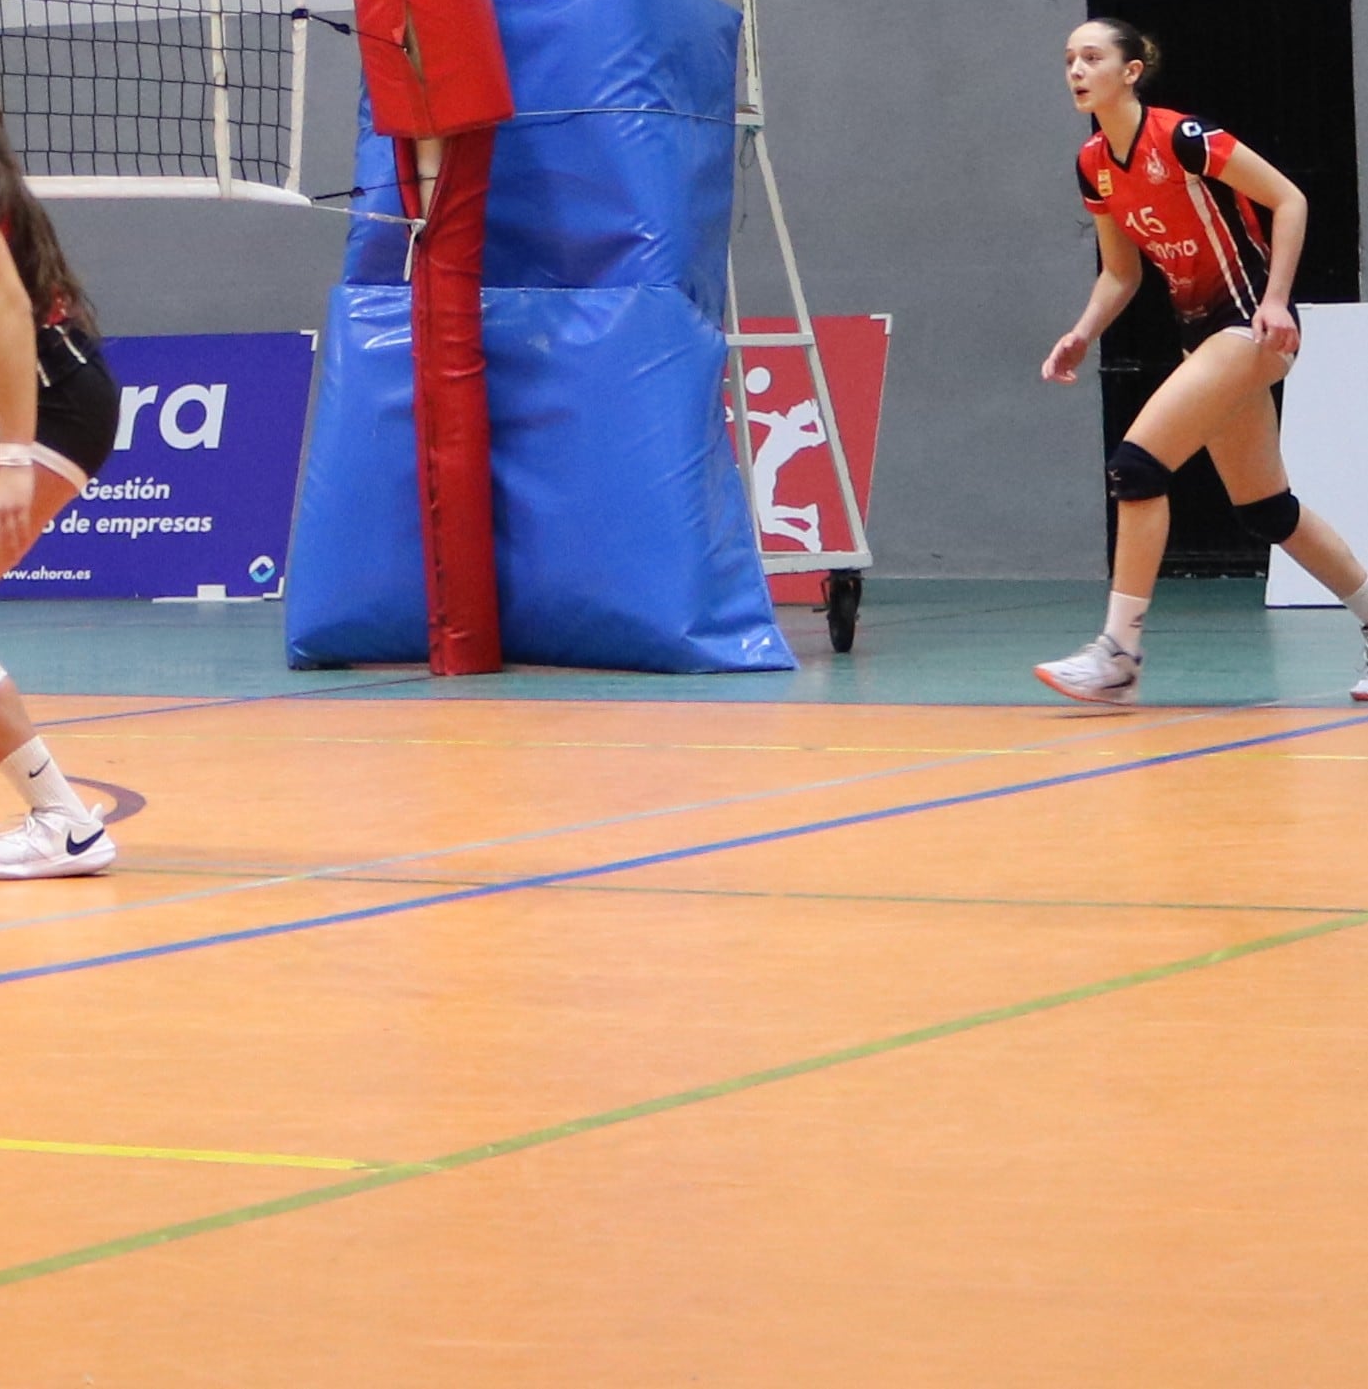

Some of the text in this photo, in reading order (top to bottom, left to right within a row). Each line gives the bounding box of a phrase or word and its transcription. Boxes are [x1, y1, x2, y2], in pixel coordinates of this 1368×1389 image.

[1125, 207, 1166, 237] 15
[81, 477, 170, 500] Gestión
[61, 510, 89, 534] de
[96, 515, 212, 539] empresas
